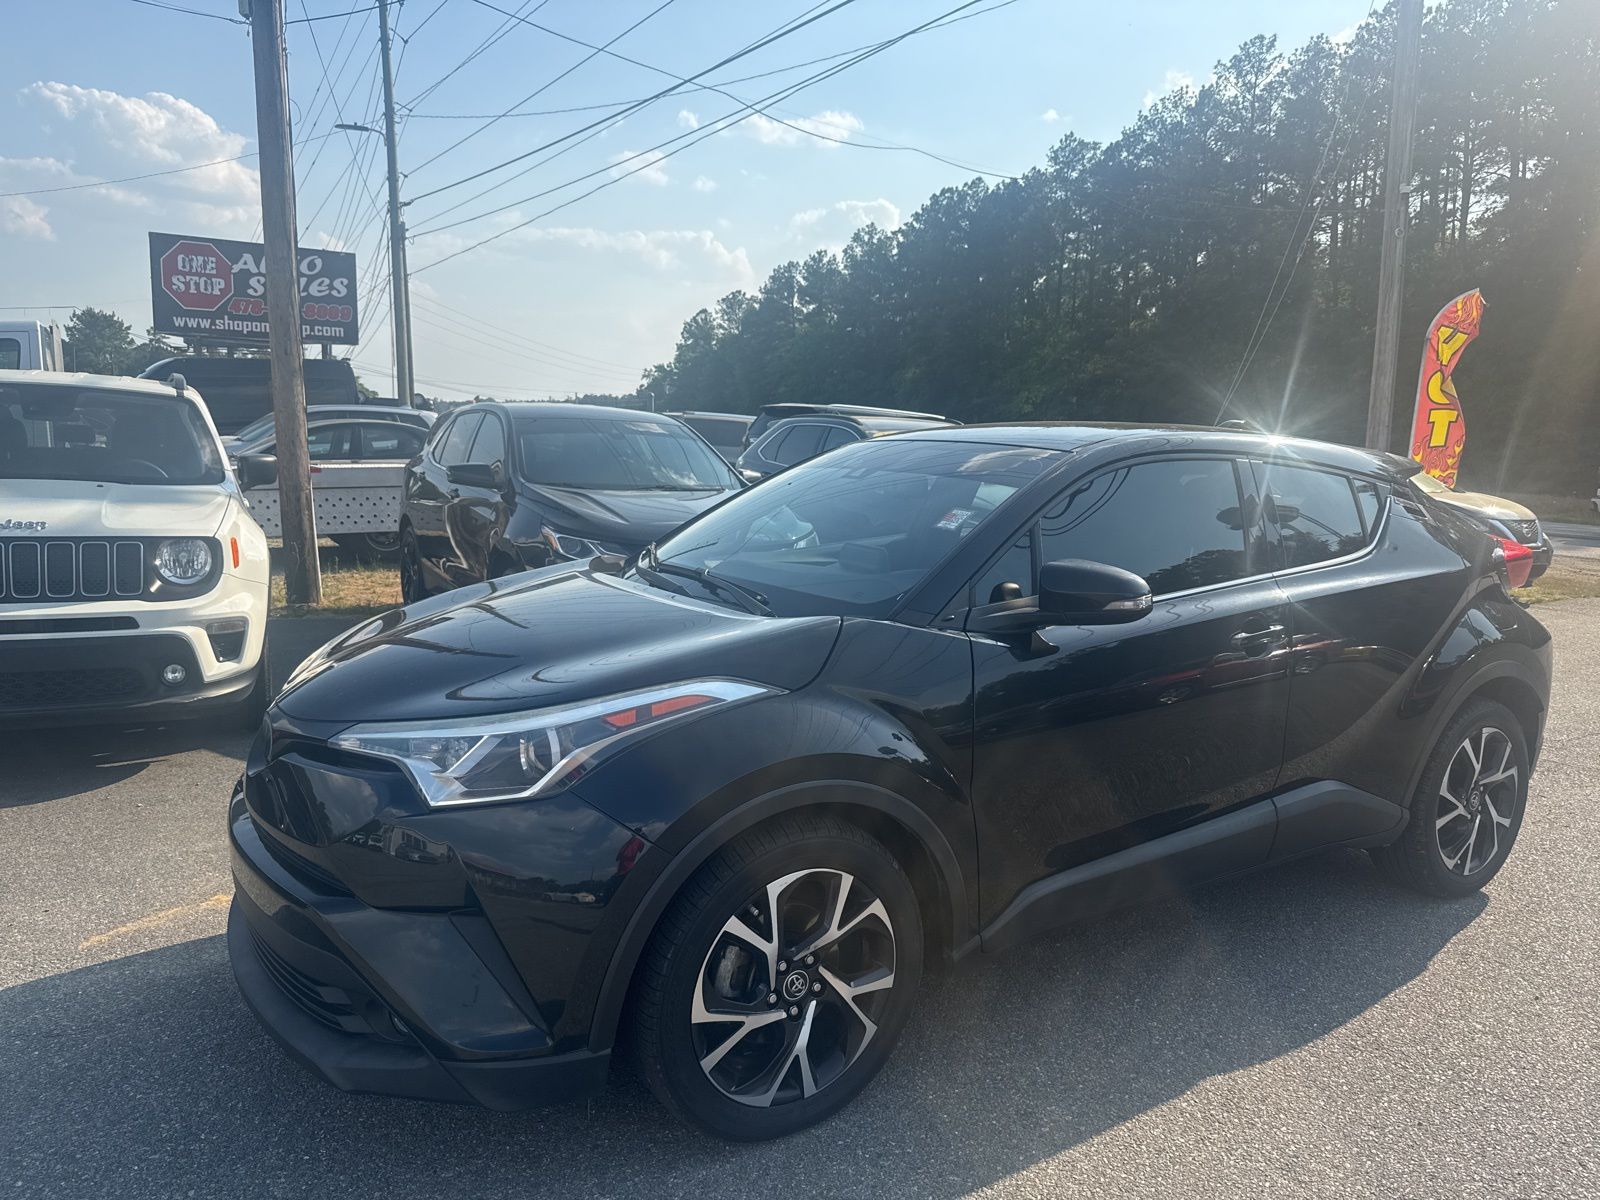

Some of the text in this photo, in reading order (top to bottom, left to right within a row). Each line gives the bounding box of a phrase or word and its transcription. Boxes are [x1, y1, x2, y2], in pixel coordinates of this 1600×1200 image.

[177, 254, 217, 275] ONE
[171, 275, 225, 295] STOP
[173, 315, 344, 337] www.shoponp.com
